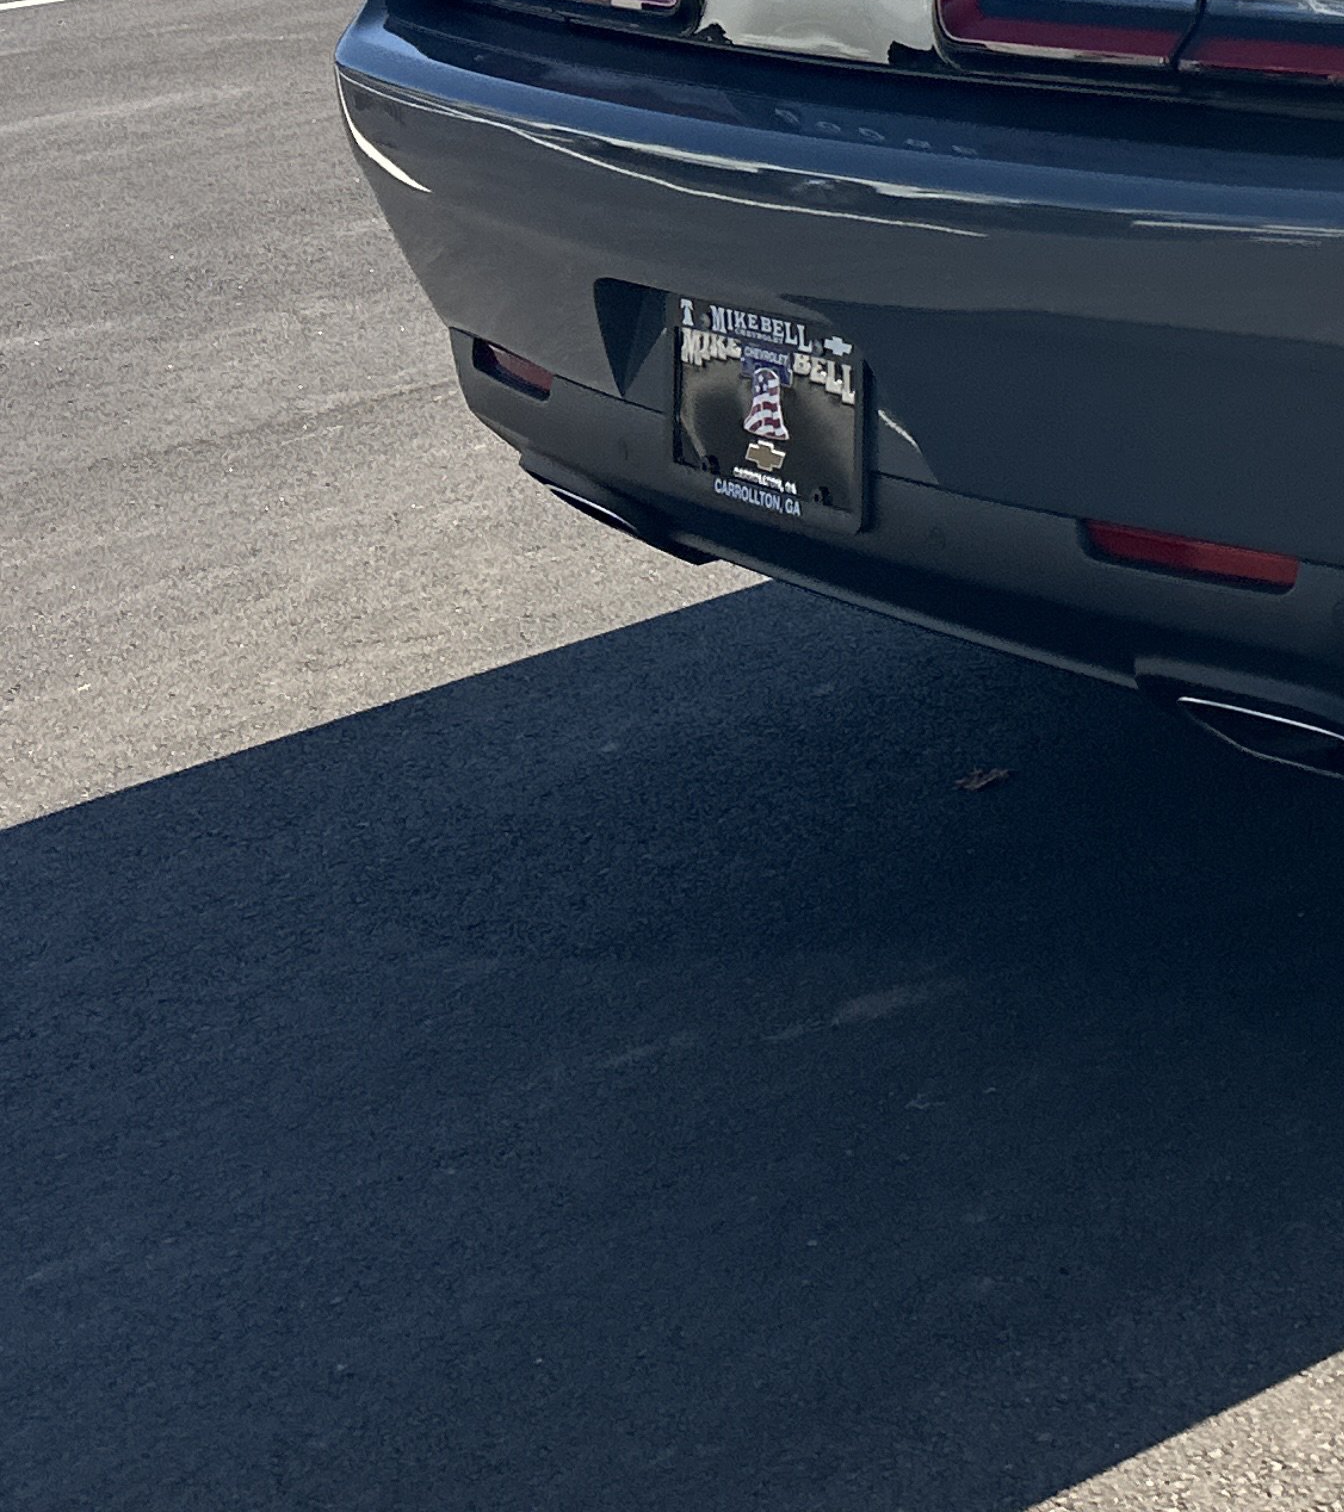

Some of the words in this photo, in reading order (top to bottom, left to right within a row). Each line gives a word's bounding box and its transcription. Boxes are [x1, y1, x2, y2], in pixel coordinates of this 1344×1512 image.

[710, 305, 758, 334] MIKE
[760, 316, 812, 353] BELL
[681, 327, 742, 367] MIKE
[793, 352, 856, 405] BELL
[743, 345, 789, 367] CHEVROLET
[714, 477, 783, 514] CARROLLTON,
[785, 497, 801, 517] GA
